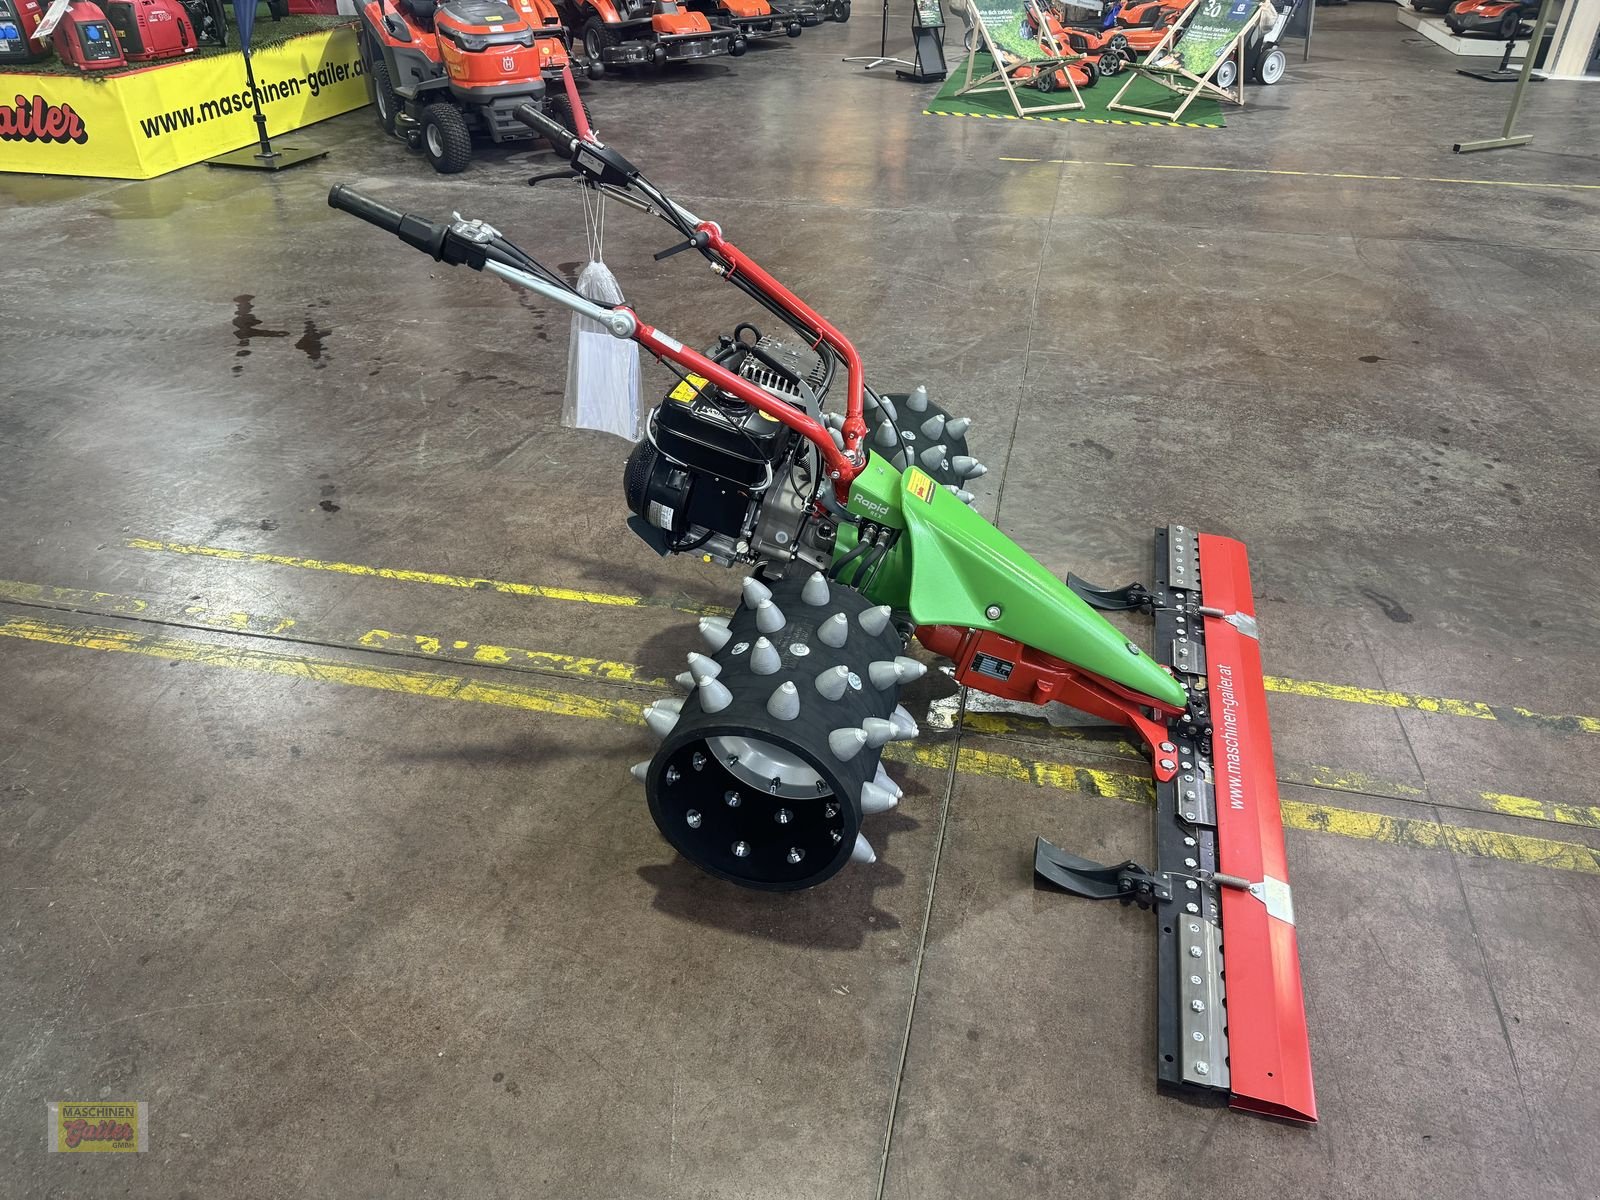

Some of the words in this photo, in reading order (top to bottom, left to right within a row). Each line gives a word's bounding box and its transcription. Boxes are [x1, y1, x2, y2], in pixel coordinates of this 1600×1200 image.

[853, 492, 889, 515] Rapid
[870, 510, 882, 519] REX
[1217, 664, 1244, 810] www.maschinen-gailer.at
